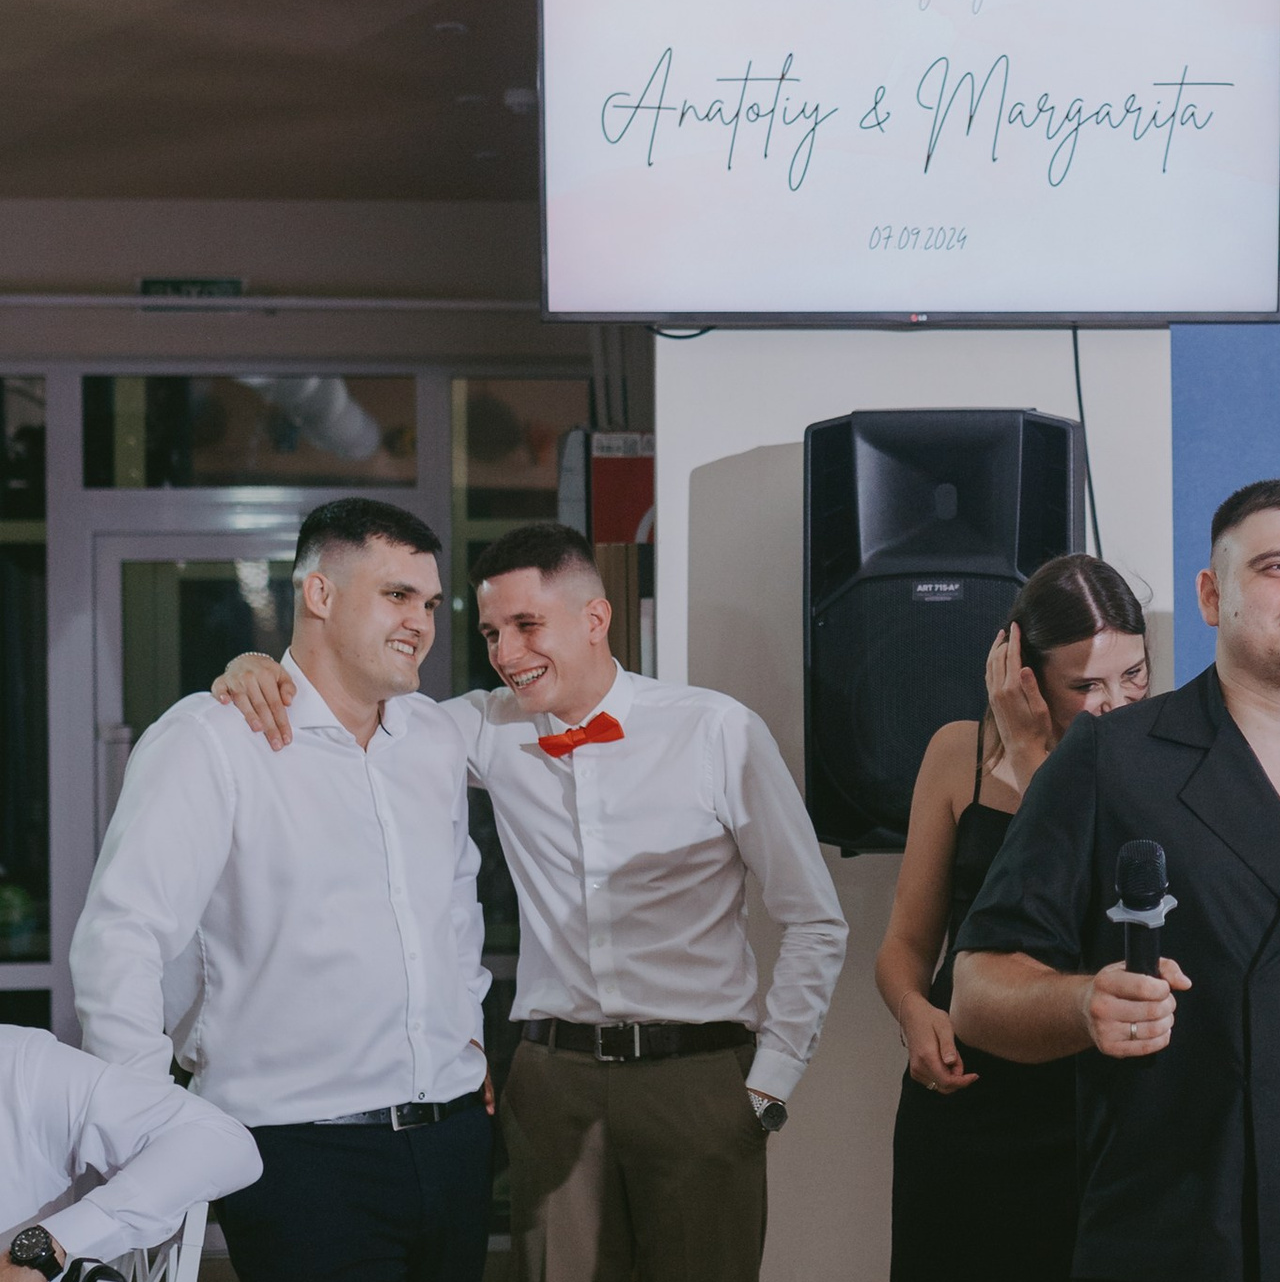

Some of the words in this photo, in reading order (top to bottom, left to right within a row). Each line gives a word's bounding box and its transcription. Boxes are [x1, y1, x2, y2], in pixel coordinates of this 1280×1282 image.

[601, 47, 838, 192] Anatoliy
[859, 85, 891, 133] &
[916, 54, 1235, 187] Margarita
[868, 225, 968, 251] 07.09.2024
